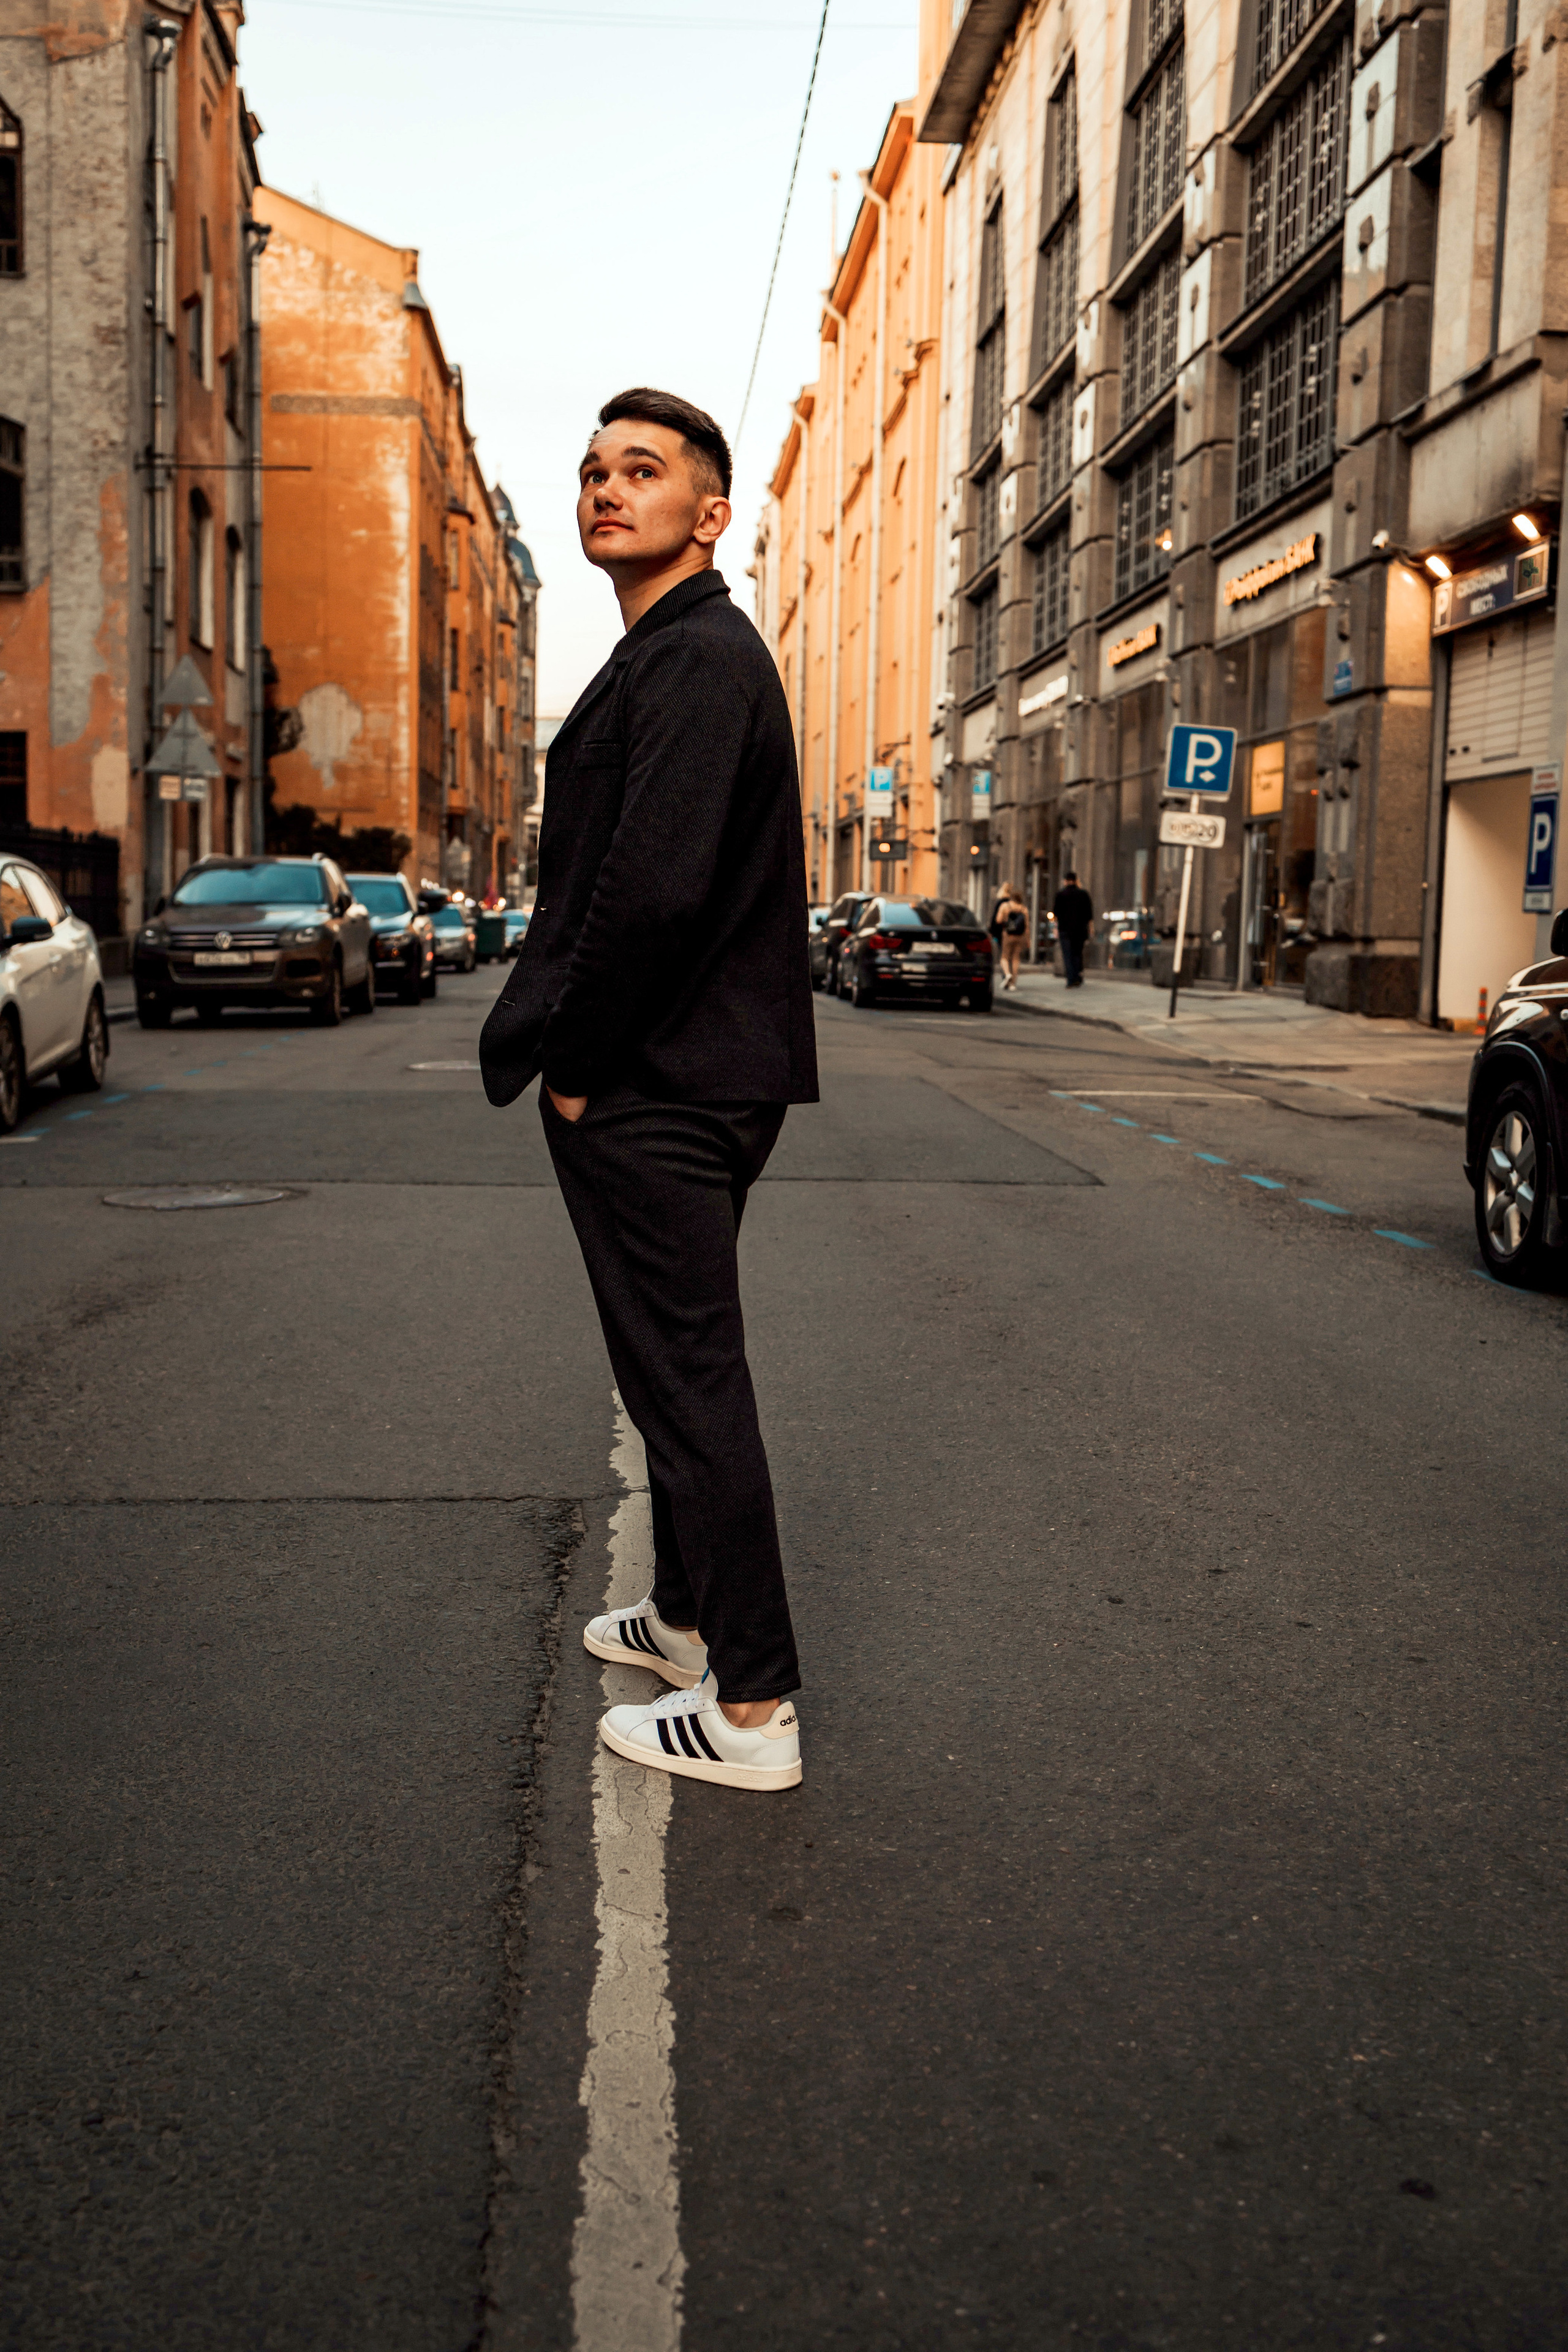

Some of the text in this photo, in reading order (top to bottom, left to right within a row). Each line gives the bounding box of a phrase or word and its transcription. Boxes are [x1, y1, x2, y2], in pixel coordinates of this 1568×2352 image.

[1435, 589, 1449, 627] P
[1185, 734, 1223, 783] P
[875, 771, 889, 791] P
[1530, 812, 1552, 875] P
